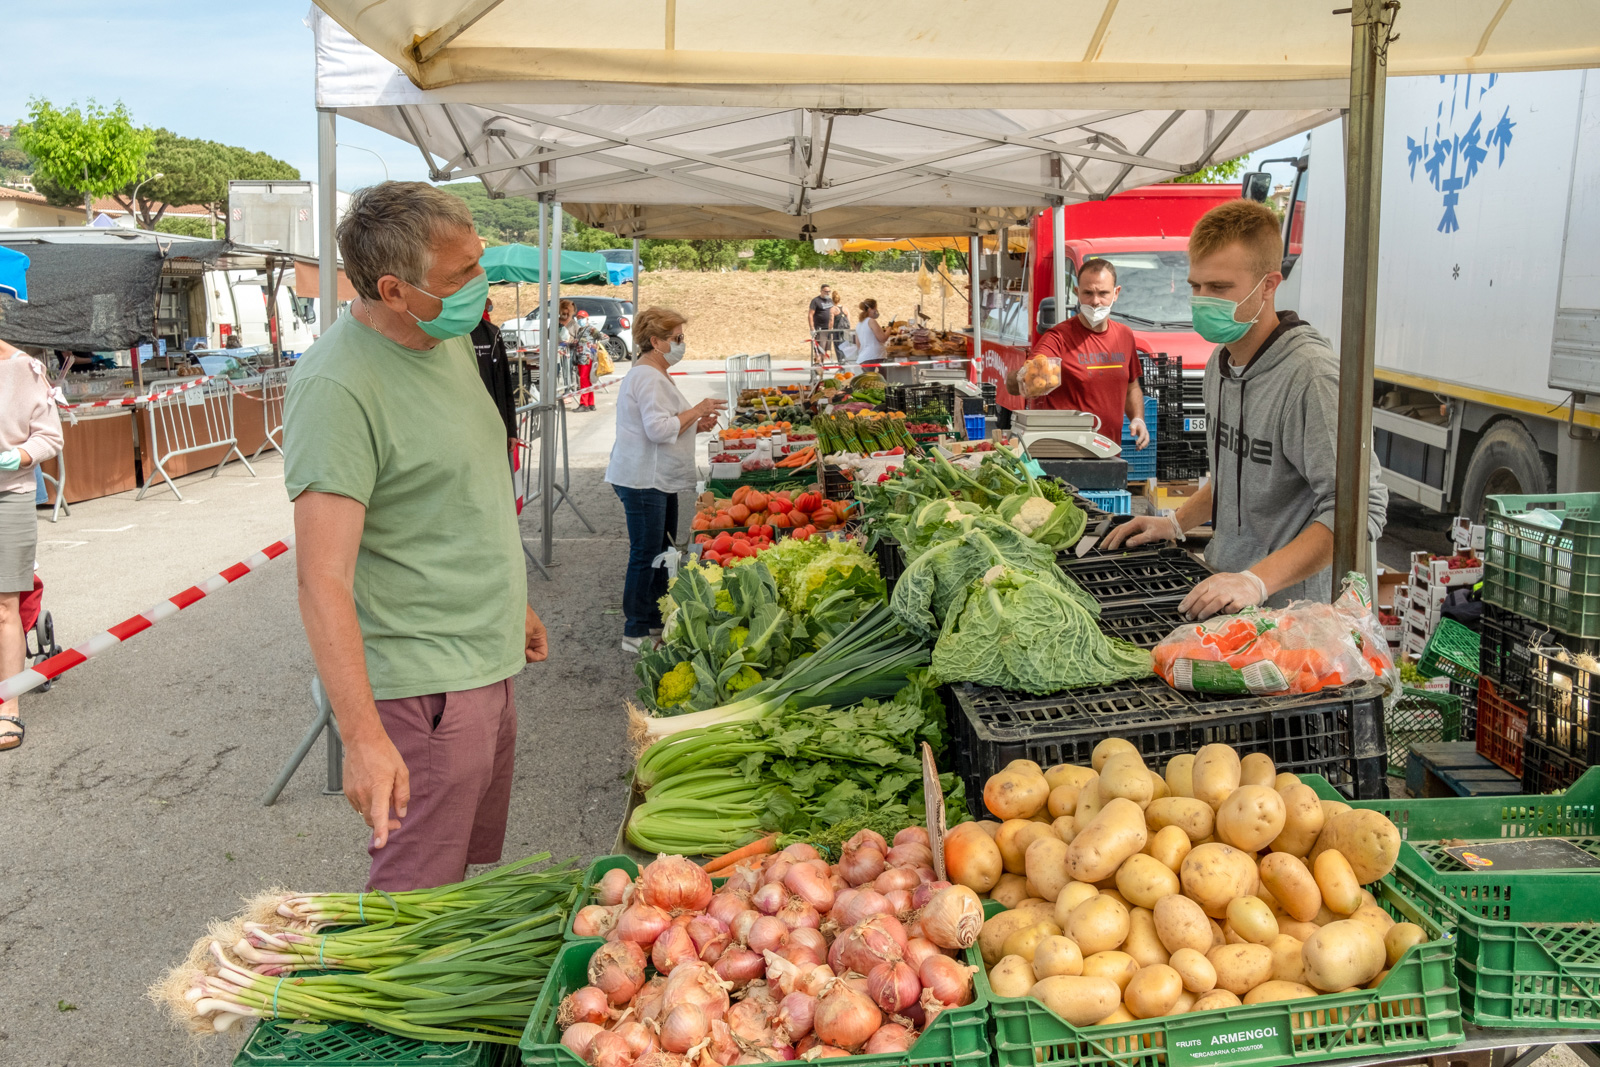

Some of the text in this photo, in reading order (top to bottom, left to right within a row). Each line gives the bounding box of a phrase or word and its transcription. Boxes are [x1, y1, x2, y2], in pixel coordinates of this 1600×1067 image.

[1078, 352, 1125, 364] CLEVELAND
[1192, 419, 1205, 430] 58
[1176, 1027, 1279, 1048] FRUITS ARMENGOL
